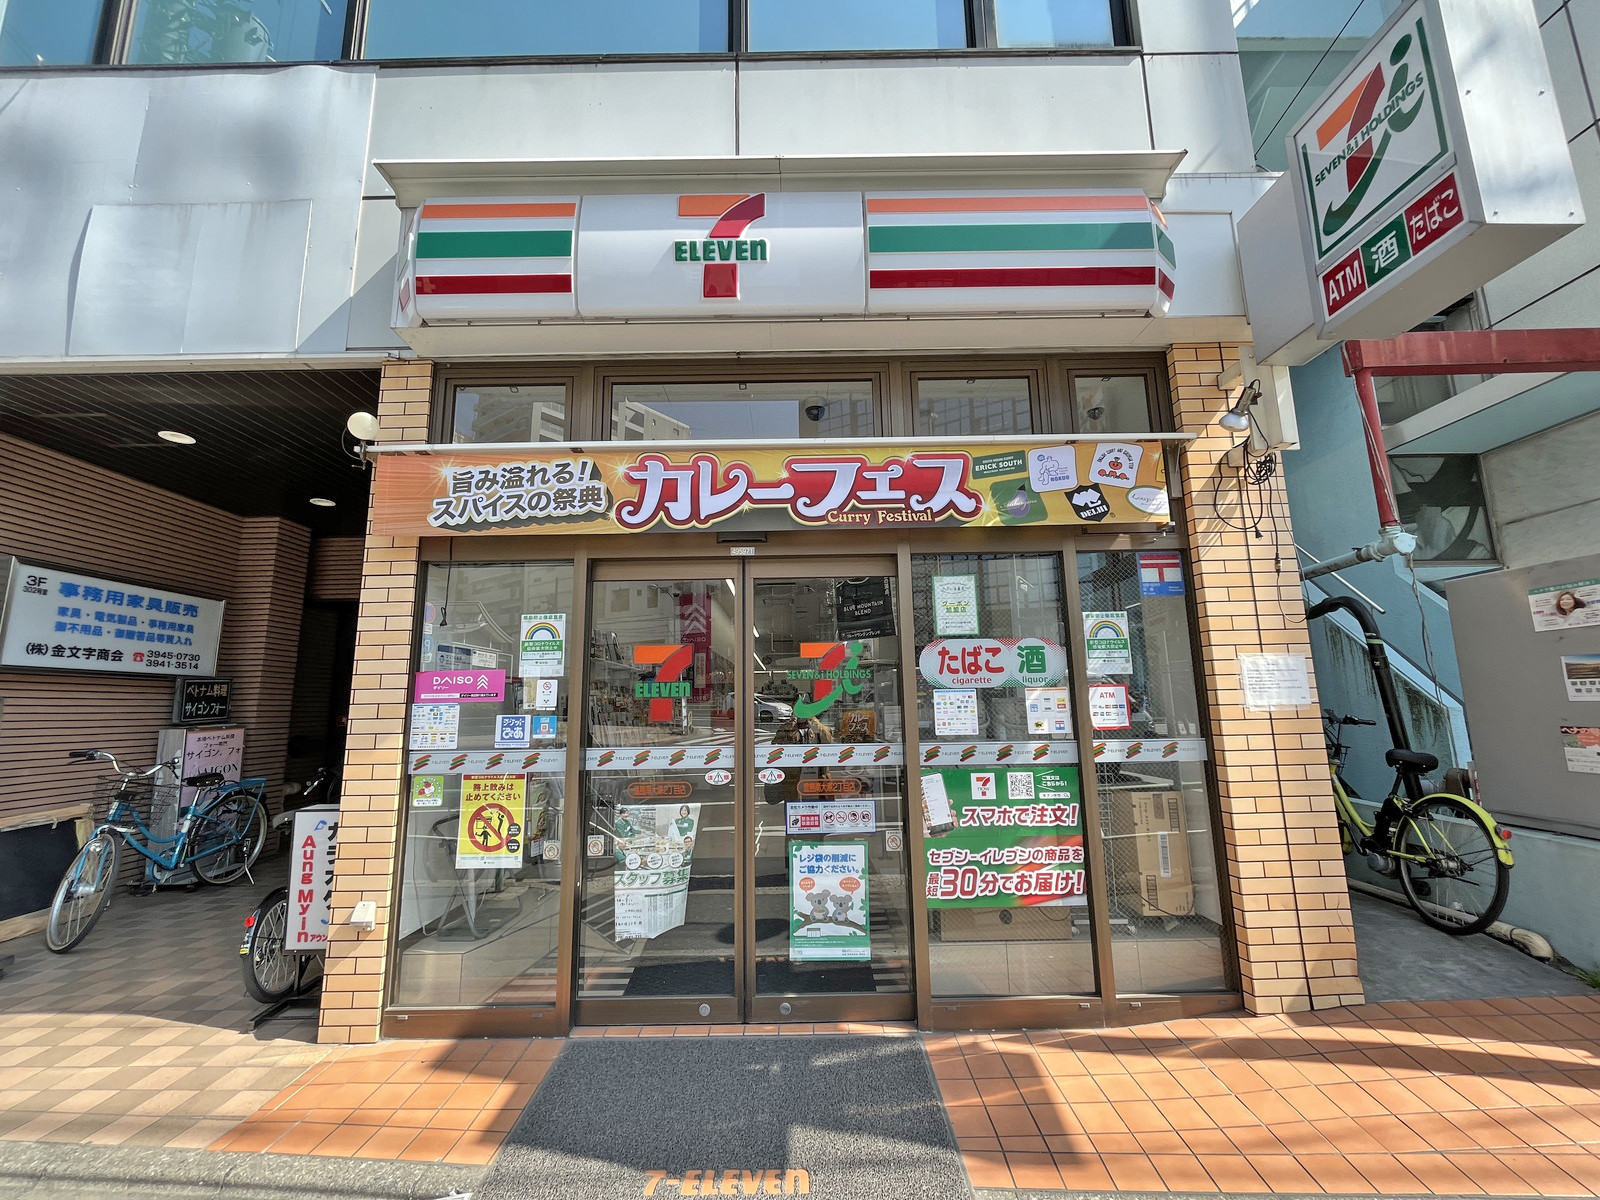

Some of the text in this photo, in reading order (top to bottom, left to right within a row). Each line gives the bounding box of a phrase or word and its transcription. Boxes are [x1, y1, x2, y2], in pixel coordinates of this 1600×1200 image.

[1360, 71, 1424, 141] HOLDINGS
[1408, 189, 1459, 244] たばこ
[1370, 230, 1398, 274] 酒
[1328, 258, 1362, 306] ATM
[975, 462, 998, 472] ERICK
[999, 459, 1023, 468] SOUTH
[452, 461, 589, 495] 旨み溢れる!
[620, 457, 980, 524] カレーフェス
[433, 485, 603, 521] スパイスの祭典
[827, 509, 933, 525] Curry Festival
[1080, 507, 1108, 520] DELHI
[26, 575, 48, 587] 3F
[58, 581, 200, 618] 事務用家具販売
[25, 642, 125, 663] (株)金文字商会
[937, 645, 1005, 675] たばこ
[1016, 645, 1047, 674] 酒
[433, 676, 474, 685] DAISO
[826, 670, 872, 680] HOLDINGS
[951, 675, 1049, 686] cigarette liquor
[186, 684, 228, 698] ベトナム料理
[1099, 691, 1116, 699] ATM
[503, 717, 525, 727] チケット
[848, 712, 870, 723] カレー
[502, 727, 524, 740] ぴあ
[848, 723, 869, 732] フェス
[473, 783, 515, 792] 路上飲みは
[465, 793, 521, 802] 止めてください
[961, 804, 1078, 826] スマホで注文!
[301, 835, 317, 885] Aung
[799, 854, 857, 863] レジ袋の削減に
[799, 864, 860, 874] ご協力ください。
[614, 869, 690, 887] スタッフ募集
[296, 889, 314, 943] Myin
